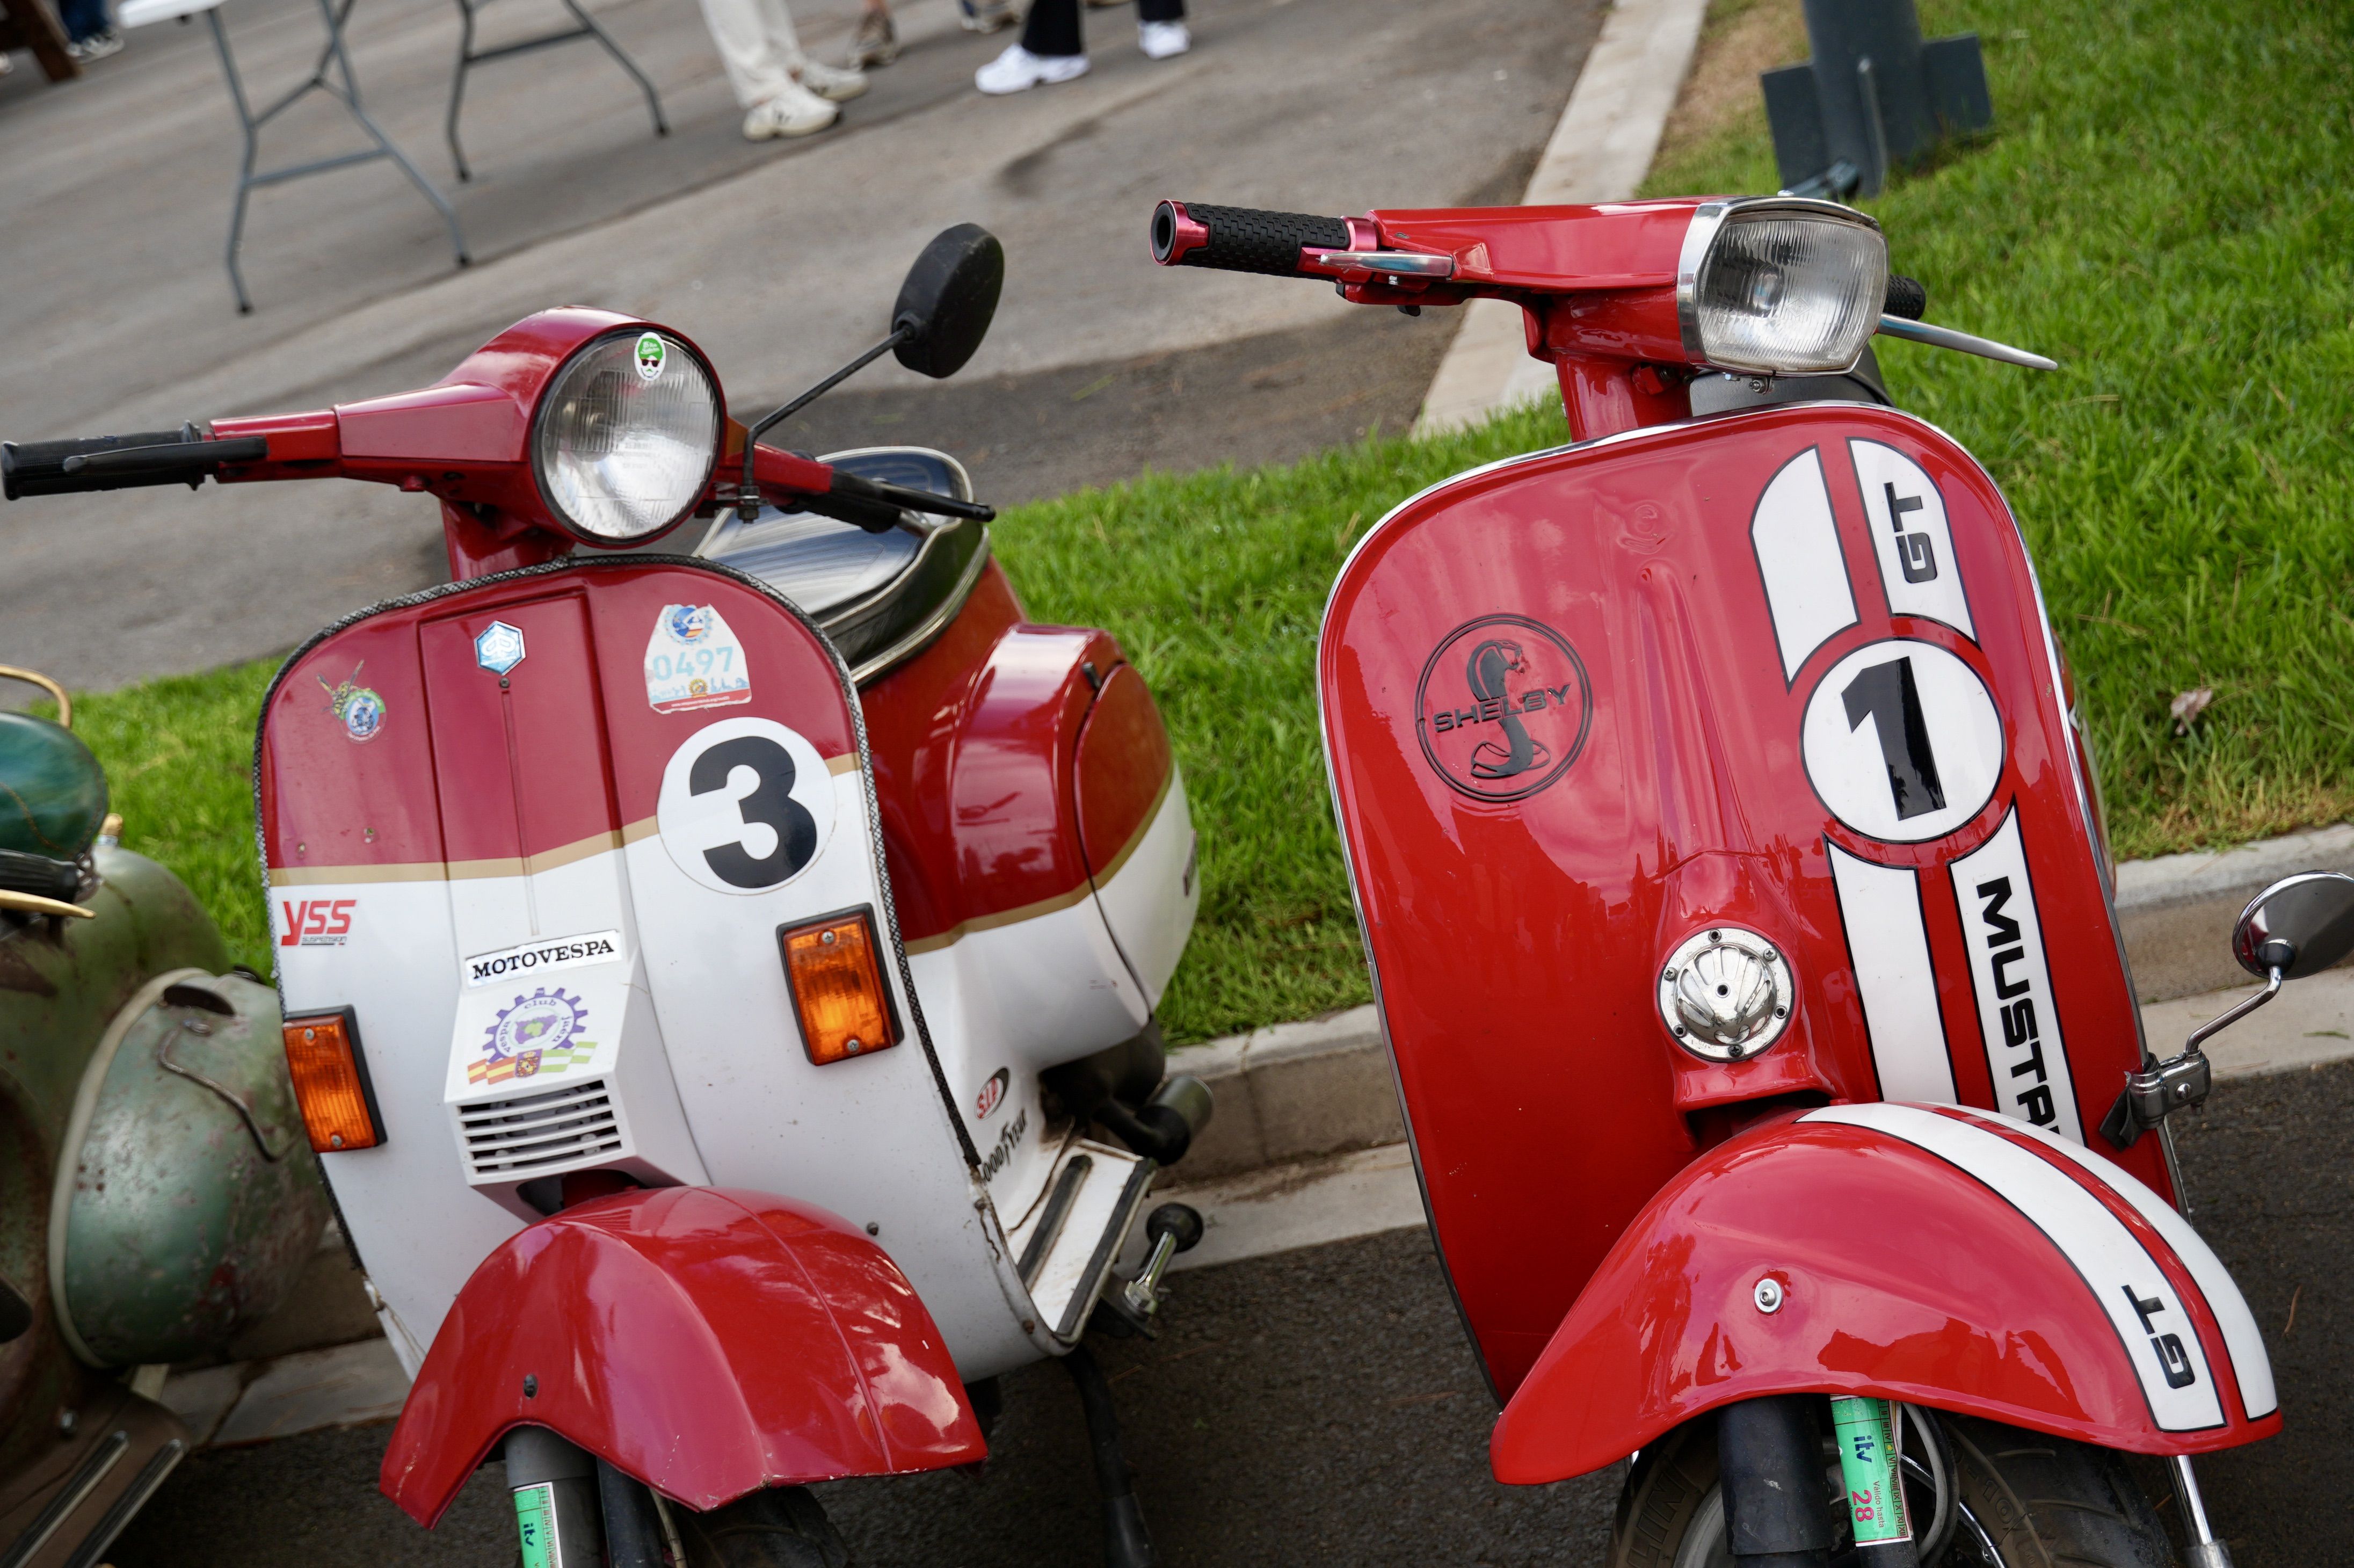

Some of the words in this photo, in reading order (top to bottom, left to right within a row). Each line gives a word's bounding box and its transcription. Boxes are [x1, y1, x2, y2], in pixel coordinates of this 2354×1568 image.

[1884, 482, 1937, 583] GT
[653, 647, 733, 681] 0497
[1434, 683, 1571, 732] SHELBY
[1841, 656, 1946, 821] 1
[689, 736, 817, 888] 3
[473, 939, 614, 979] MOTOVESPA
[525, 999, 556, 1009] club
[1976, 876, 2060, 1135] MUSTA
[2121, 1284, 2195, 1389] GT
[1854, 1435, 1875, 1463] itv
[1852, 1490, 1874, 1522] 28
[1873, 1480, 1881, 1506] Válido
[1894, 1491, 1900, 1499] IX
[524, 1522, 536, 1546] itv
[1876, 1507, 1884, 1528] hasta
